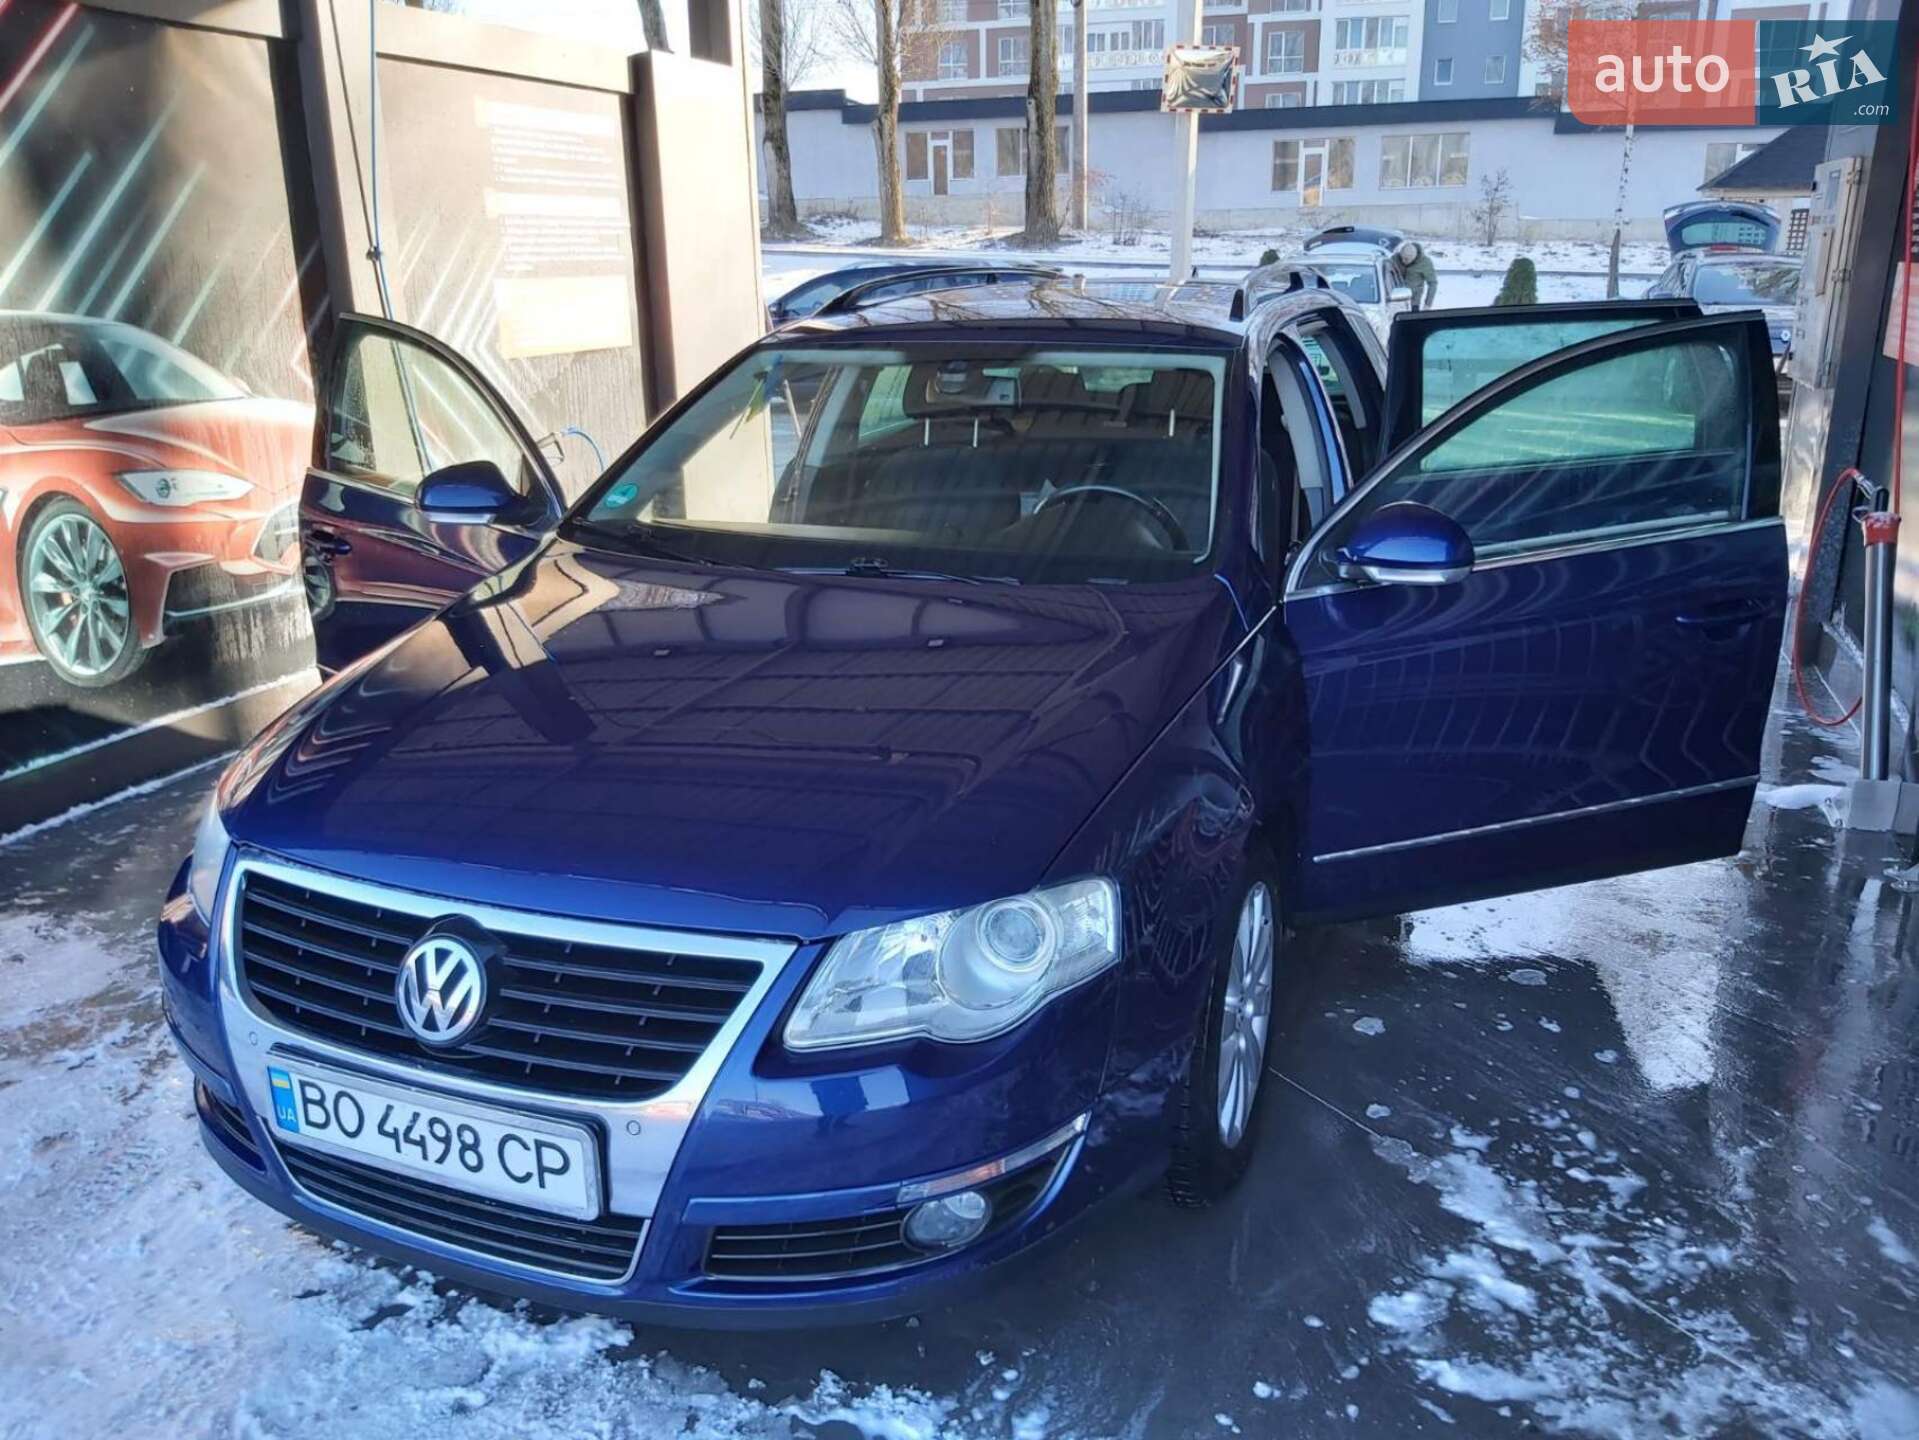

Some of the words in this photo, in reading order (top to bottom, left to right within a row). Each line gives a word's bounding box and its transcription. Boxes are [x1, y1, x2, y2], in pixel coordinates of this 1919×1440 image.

[298, 1078, 365, 1139] BO
[377, 1103, 484, 1174] 4498
[497, 1133, 571, 1189] CP
